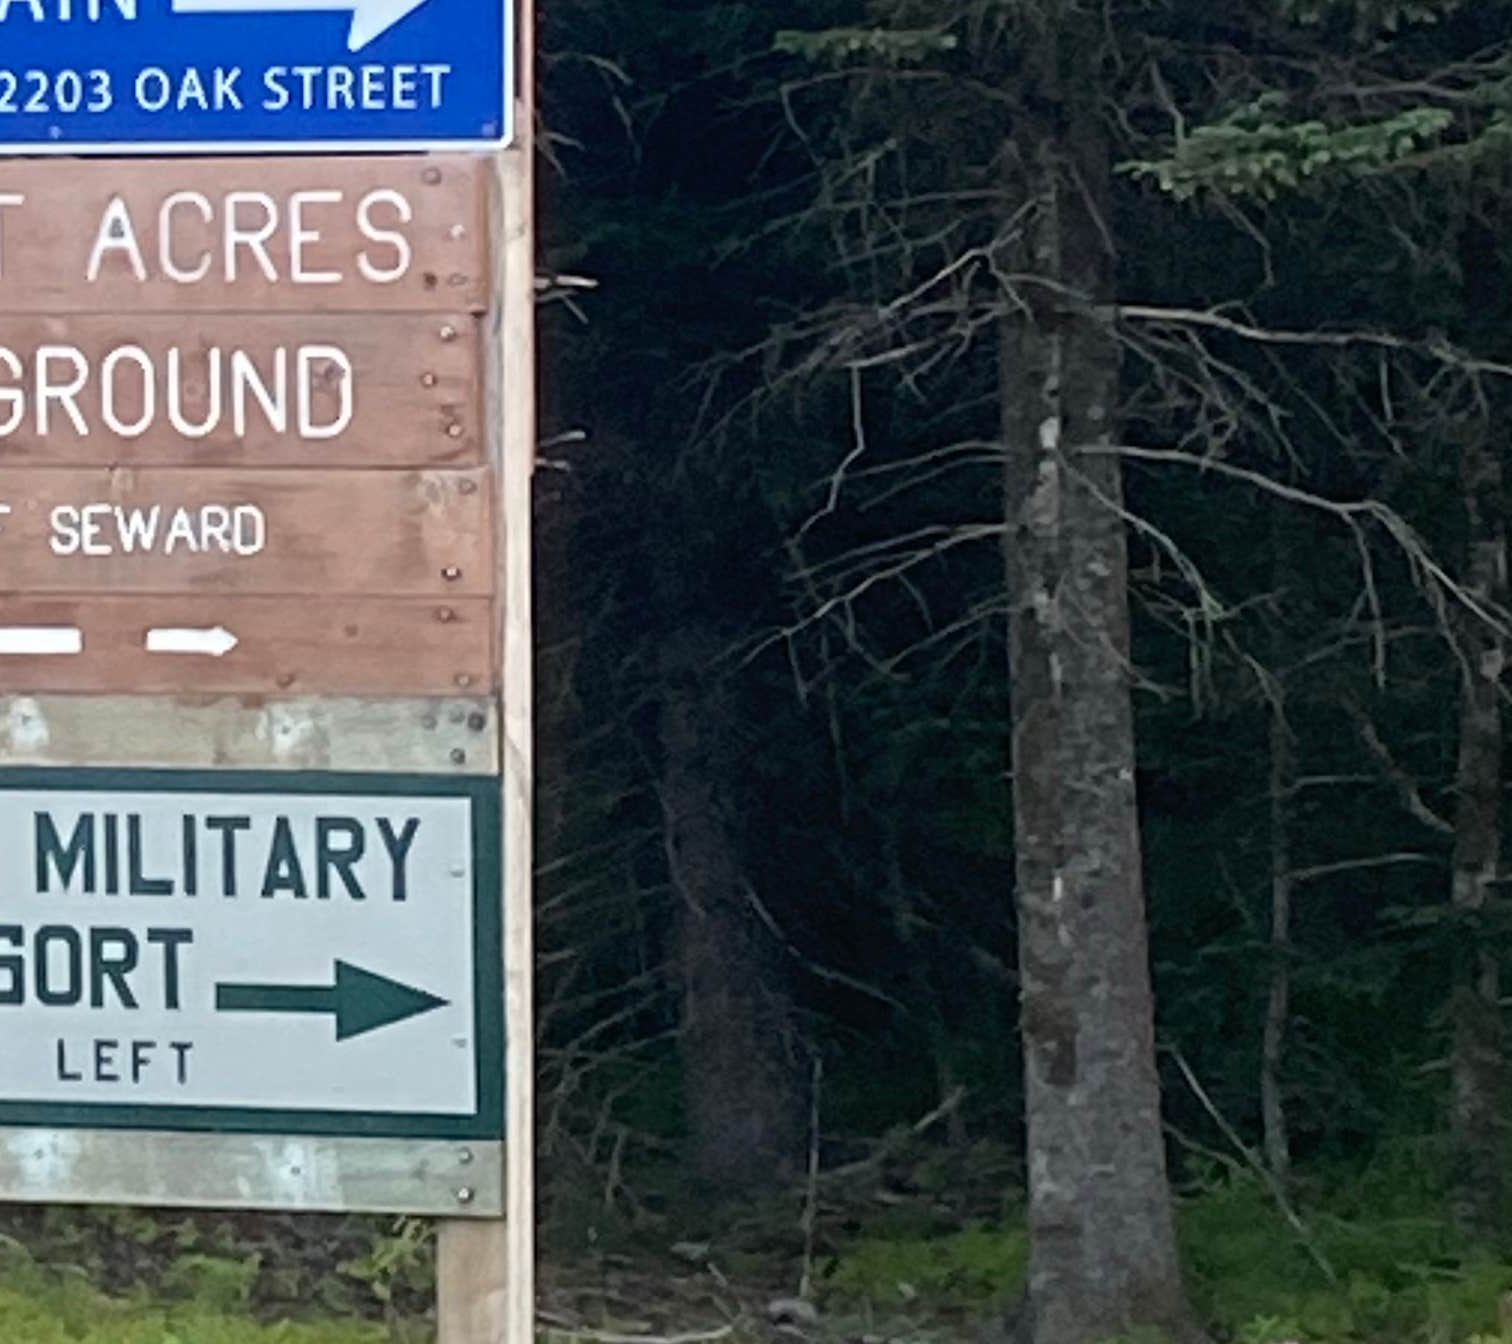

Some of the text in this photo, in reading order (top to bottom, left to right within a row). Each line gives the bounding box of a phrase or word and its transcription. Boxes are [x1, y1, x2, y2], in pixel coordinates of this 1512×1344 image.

[134, 66, 244, 112] OAK
[262, 63, 452, 111] STREET
[85, 188, 413, 284] ACRES
[49, 502, 266, 556] SEWARD
[32, 810, 422, 903] MILITARY
[56, 1037, 194, 1086] LEFT
